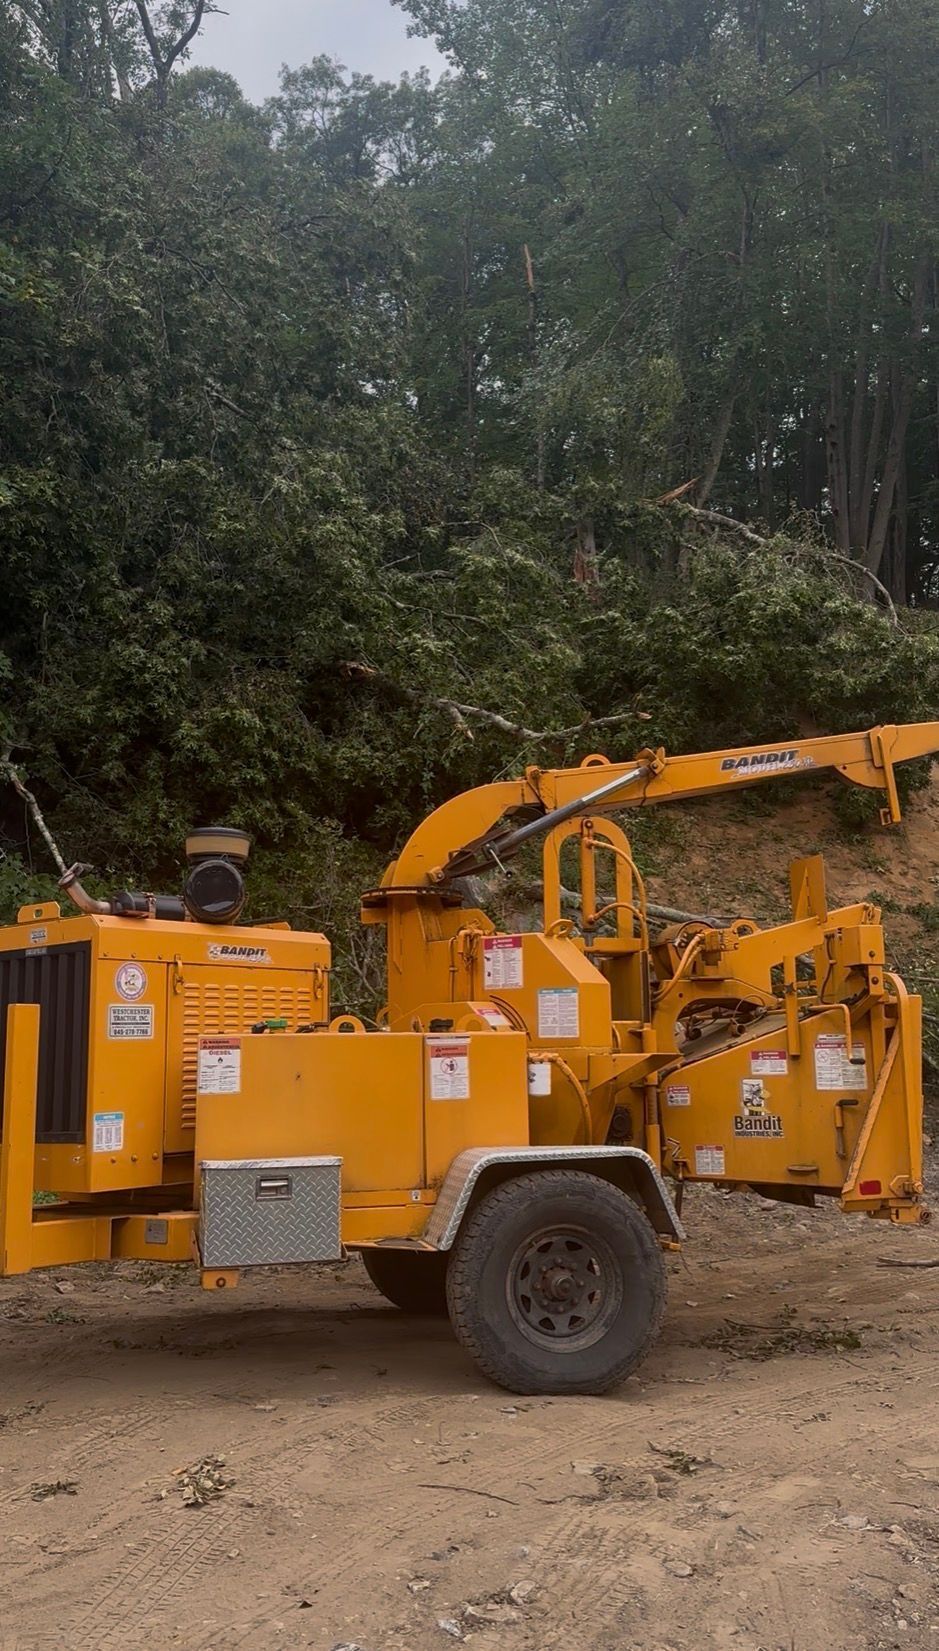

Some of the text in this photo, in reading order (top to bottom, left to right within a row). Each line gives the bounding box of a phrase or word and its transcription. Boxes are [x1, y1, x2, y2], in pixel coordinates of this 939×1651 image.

[720, 749, 799, 771] BANDIT
[220, 945, 266, 957] BANDIT
[734, 1115, 783, 1131] Bandit
